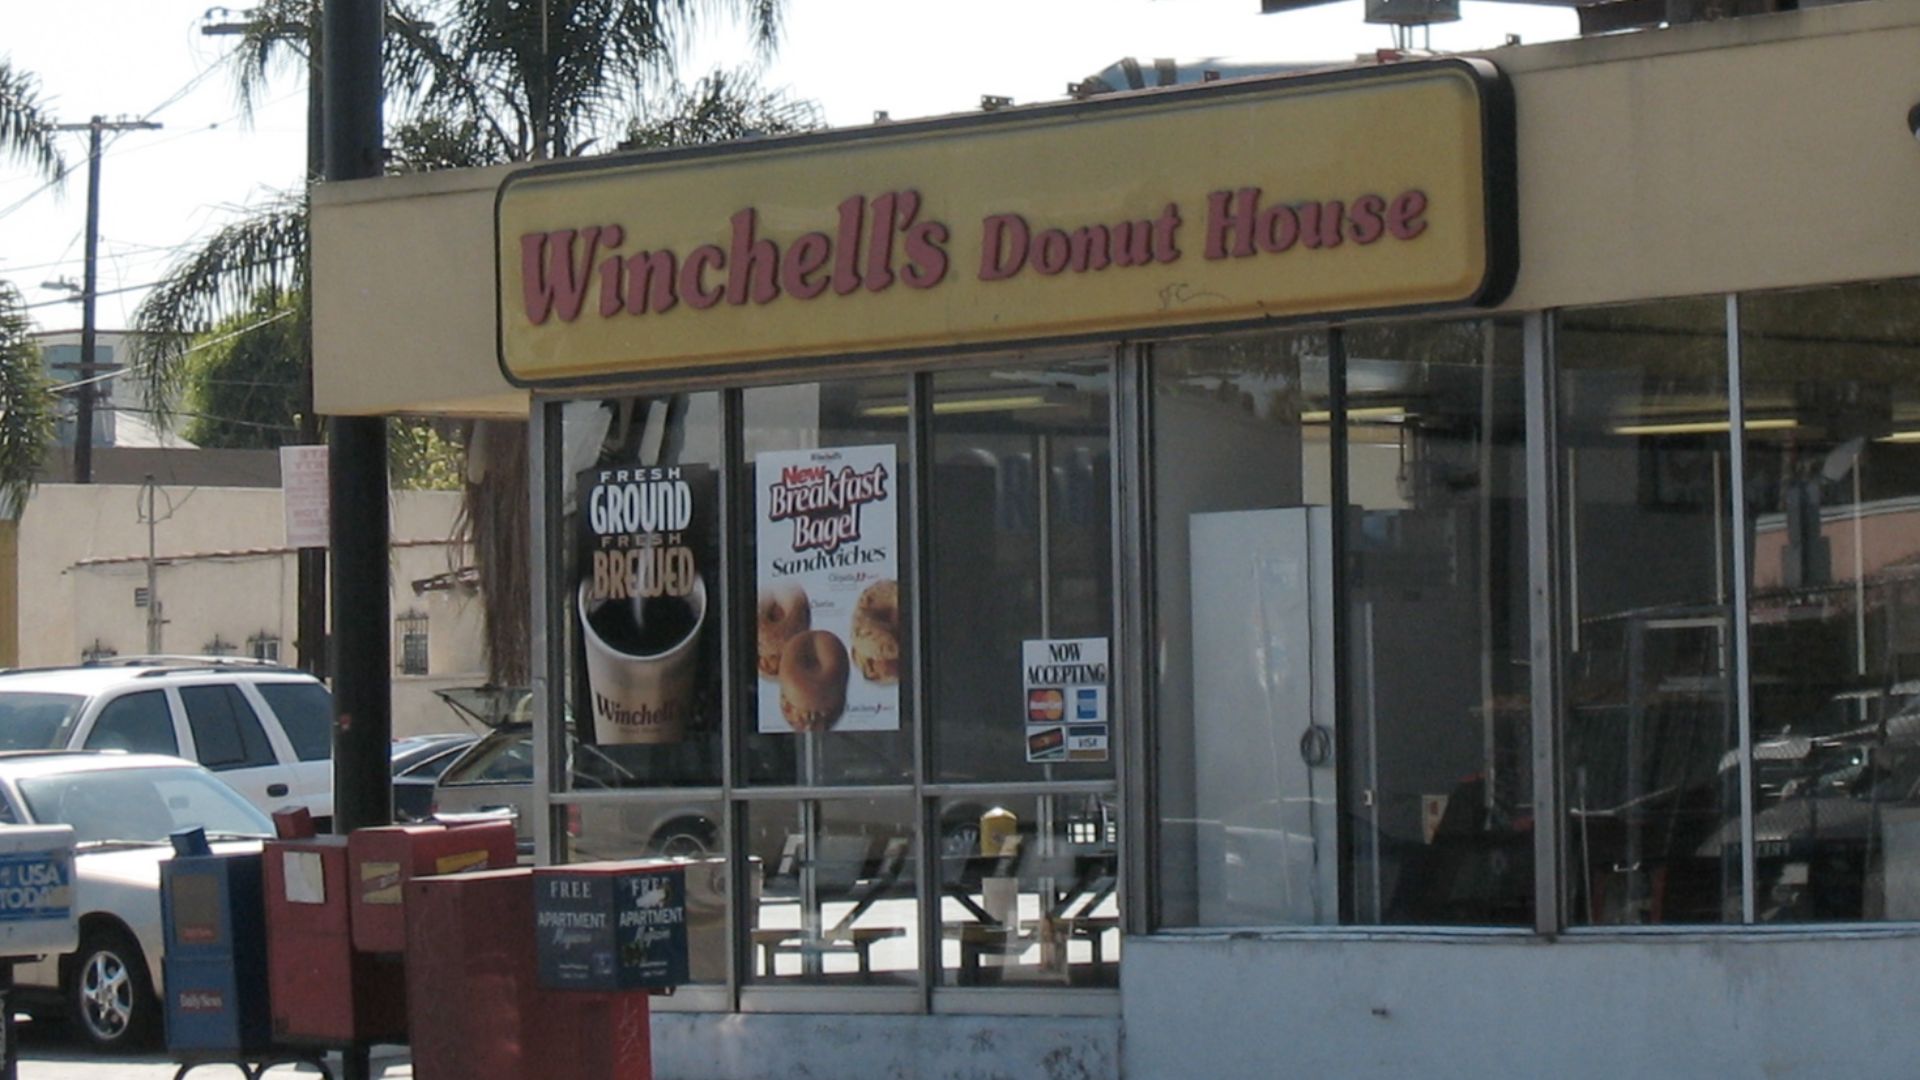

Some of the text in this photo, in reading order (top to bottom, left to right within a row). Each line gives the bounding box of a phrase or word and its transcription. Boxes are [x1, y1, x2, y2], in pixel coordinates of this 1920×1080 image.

[519, 186, 1429, 326] Winchell's Donut House
[600, 466, 681, 483] FRESH
[783, 464, 826, 485] New
[769, 462, 888, 522] Breakfast
[590, 480, 692, 534] GROUND
[792, 502, 861, 553] Bagel
[601, 532, 682, 548] FRESH
[771, 545, 887, 577] Sandwiches
[593, 546, 695, 599] BREWED
[1048, 642, 1081, 662] NOW
[1027, 662, 1106, 684] ACCEPTING
[18, 863, 60, 887] USA
[549, 880, 592, 899] FREE
[537, 911, 606, 928] APARTMENT
[618, 907, 683, 927] APARTMENT
